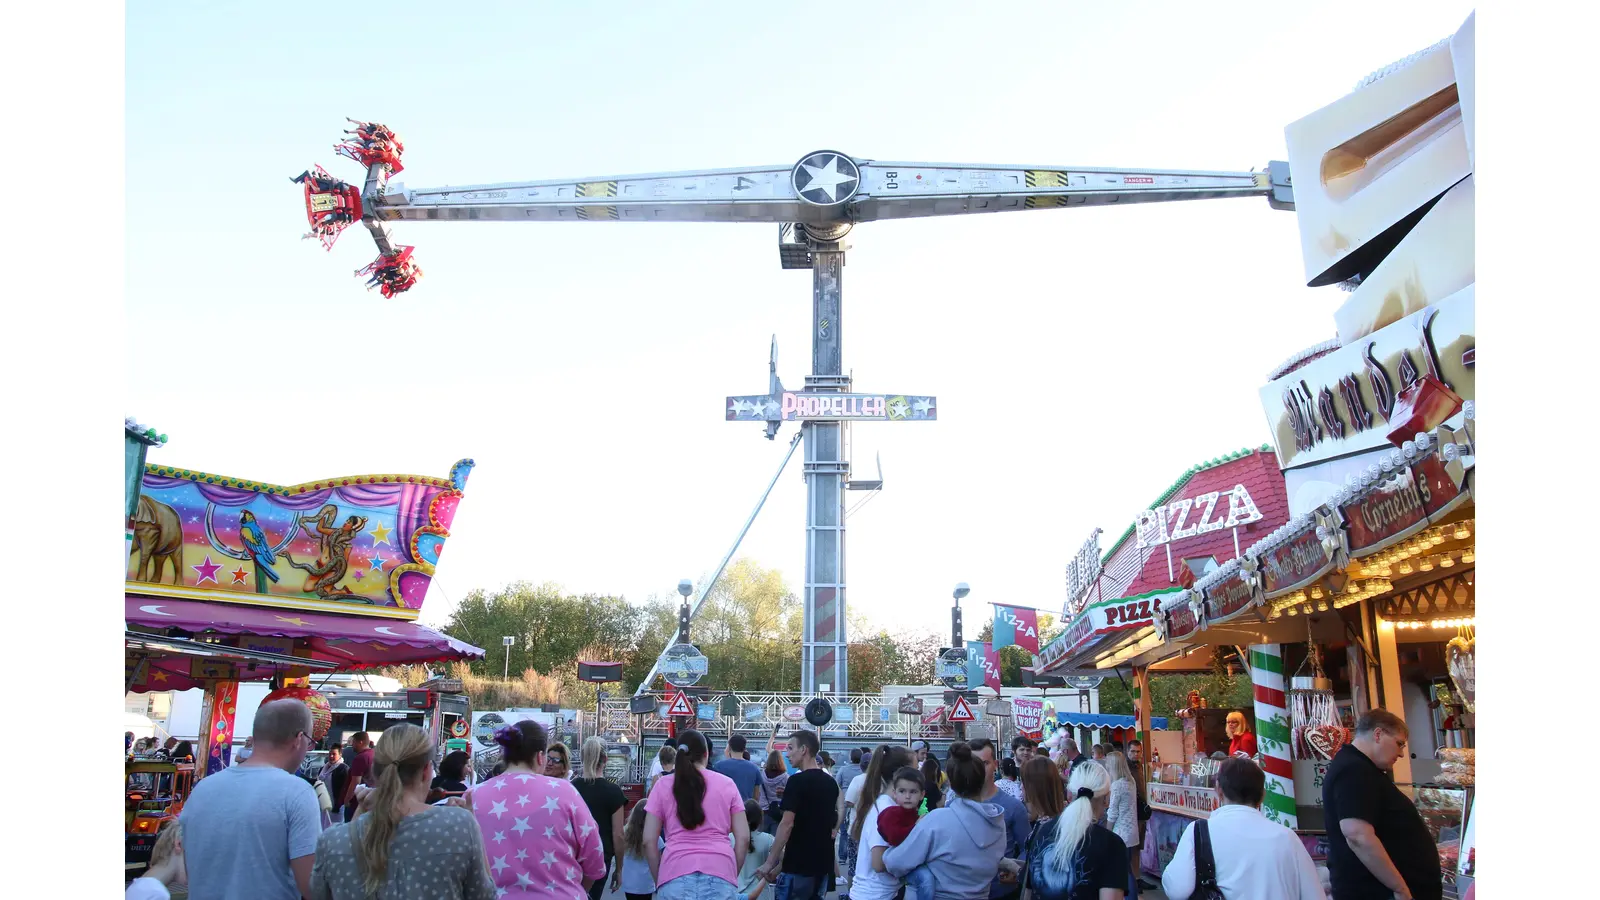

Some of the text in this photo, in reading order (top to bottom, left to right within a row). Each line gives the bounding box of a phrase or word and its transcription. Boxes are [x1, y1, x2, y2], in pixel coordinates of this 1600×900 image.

[780, 392, 886, 418] PROPELLER
[1135, 484, 1263, 548] PIZZA
[996, 606, 1036, 638] PIZZA
[970, 648, 1000, 680] PIZZA
[346, 700, 392, 708] ORDELMAN
[1184, 790, 1196, 810] Viva
[1196, 792, 1212, 812] Italia
